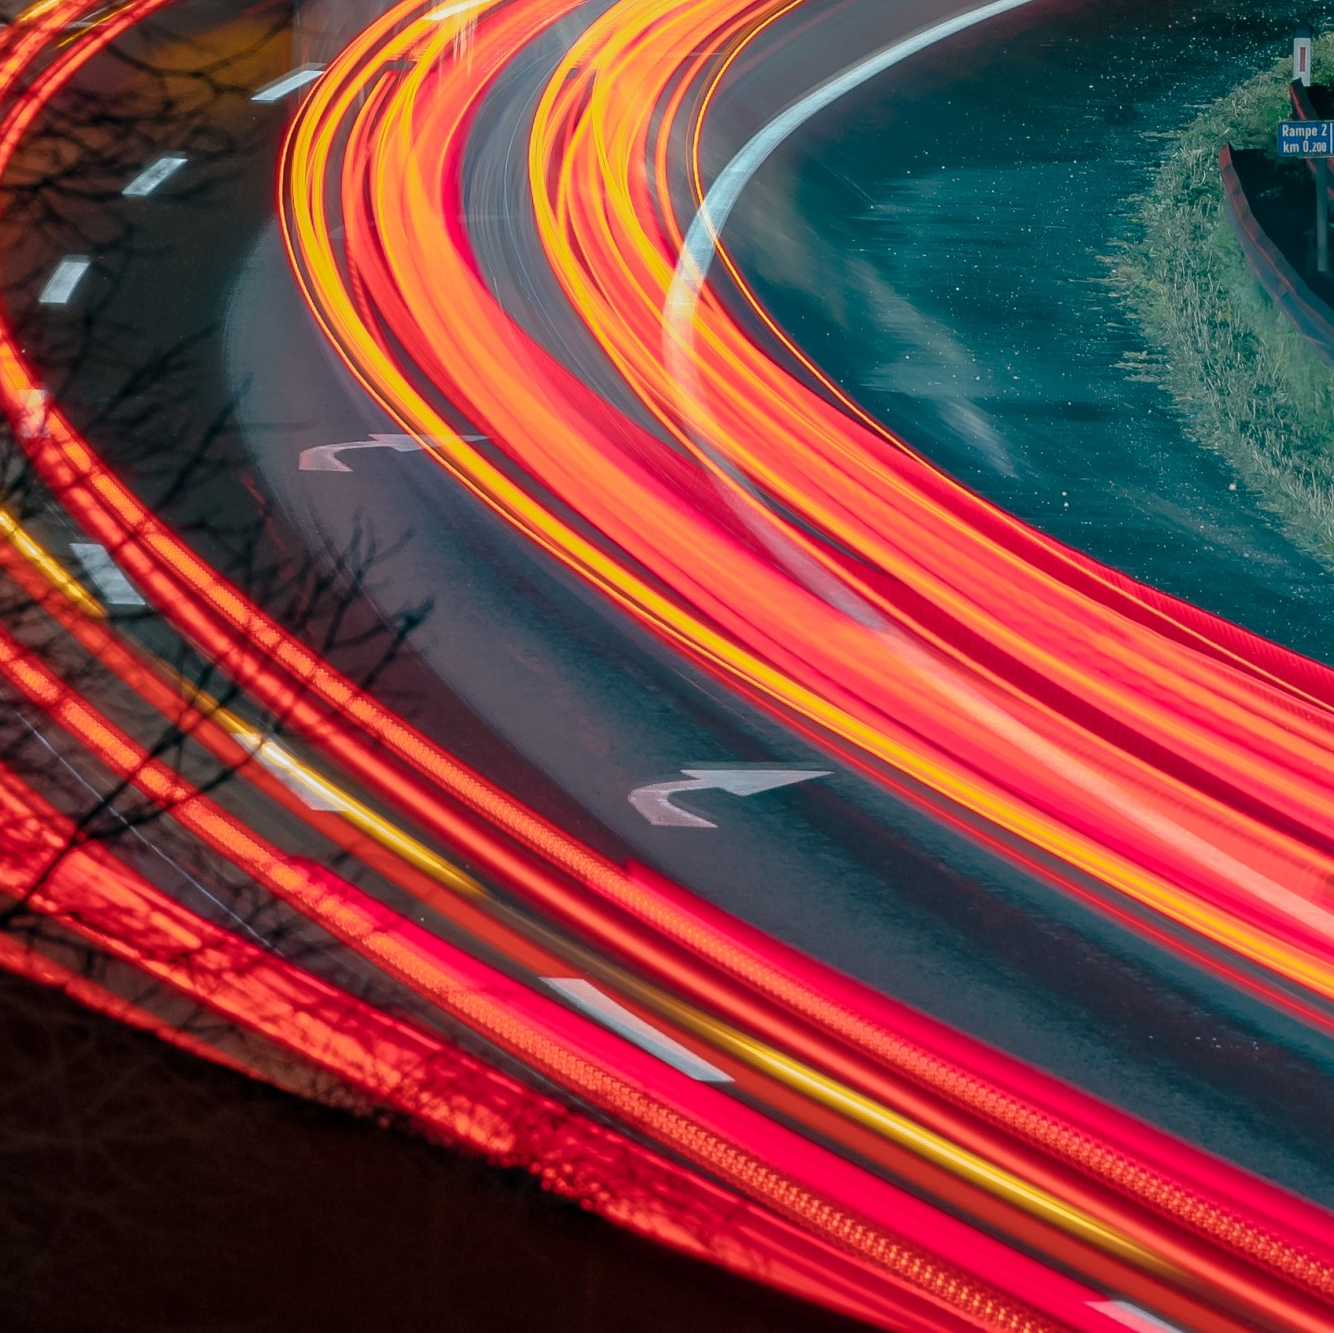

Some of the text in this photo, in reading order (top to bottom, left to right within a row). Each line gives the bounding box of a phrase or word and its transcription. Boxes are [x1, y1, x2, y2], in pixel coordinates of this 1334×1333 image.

[1282, 124, 1328, 140] Rampe 2
[1283, 141, 1299, 153] km
